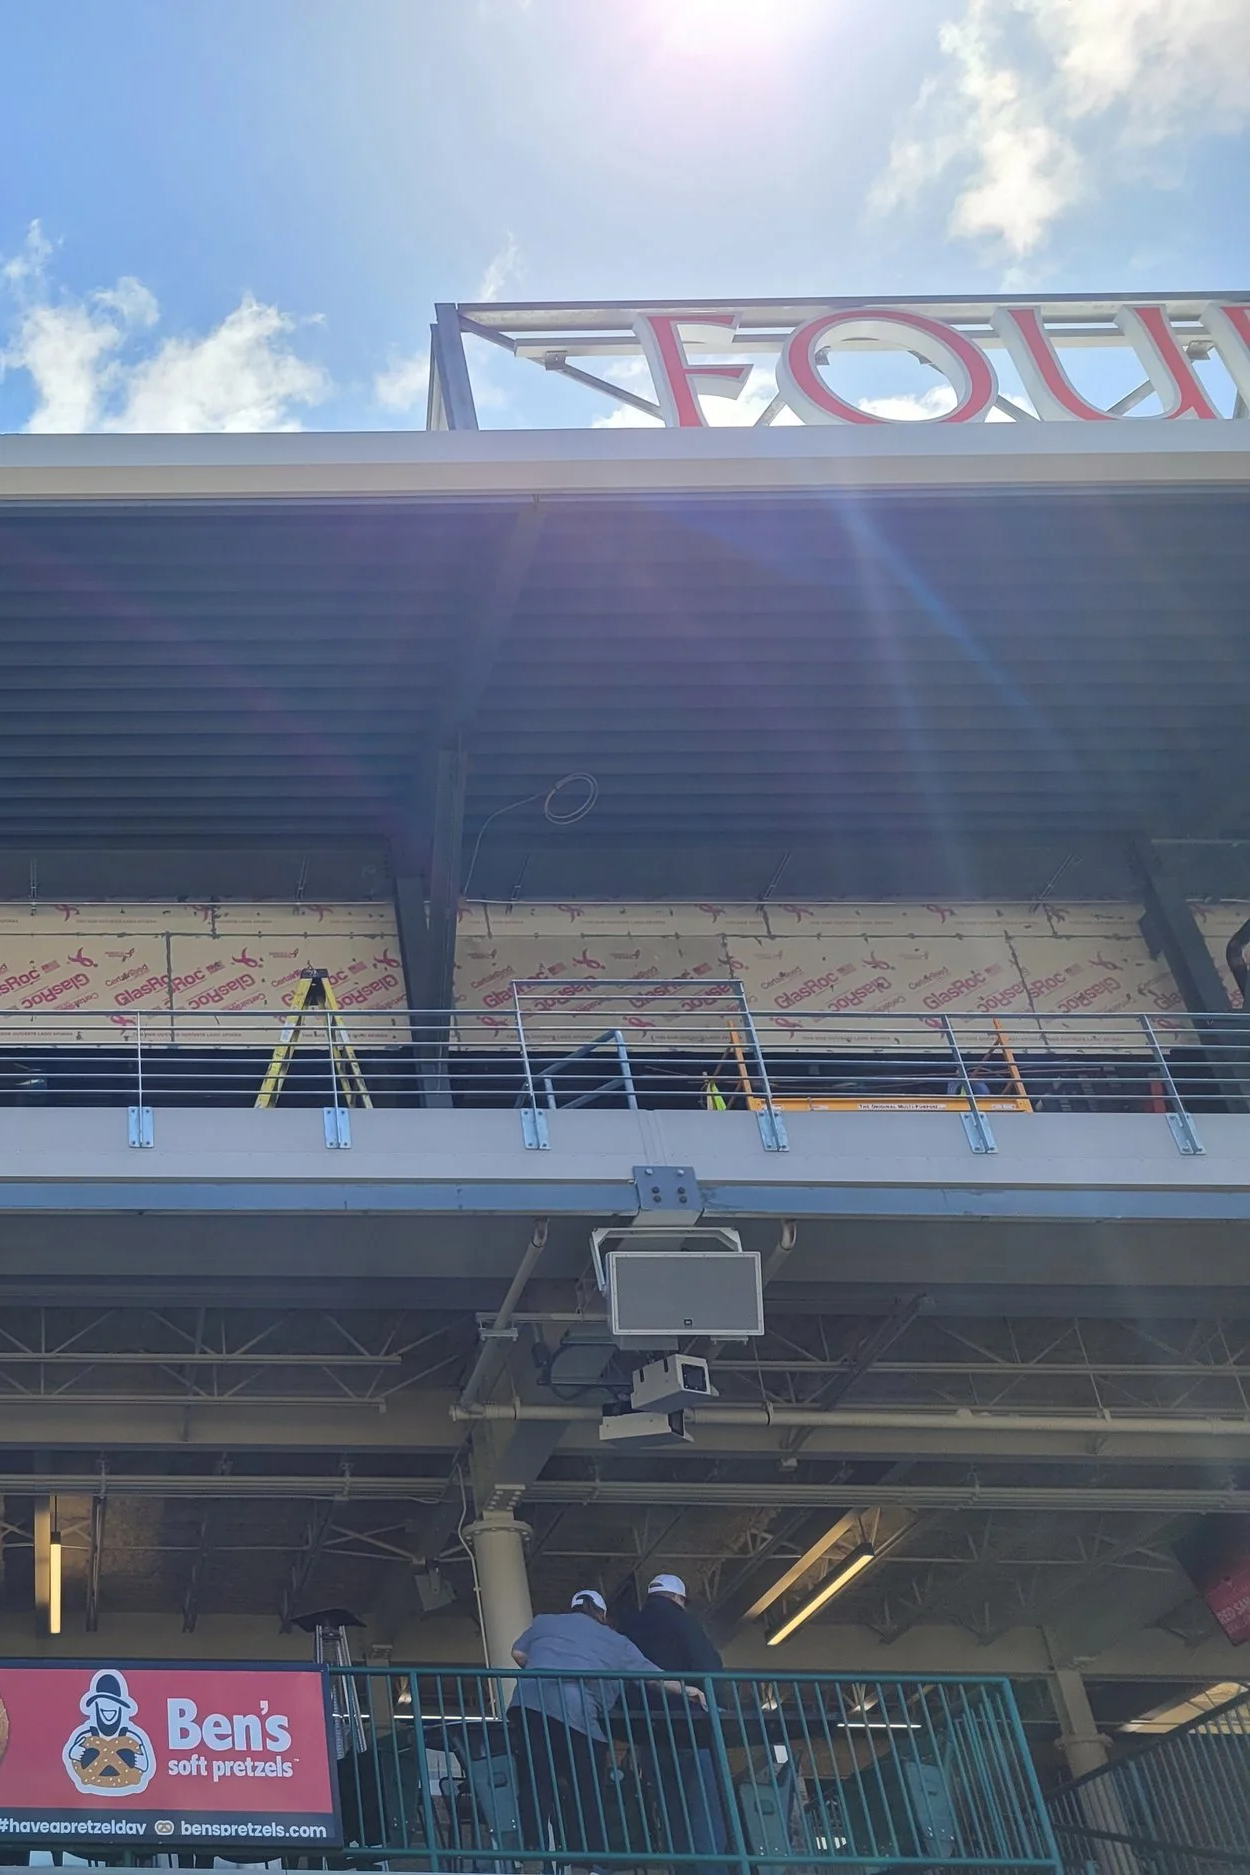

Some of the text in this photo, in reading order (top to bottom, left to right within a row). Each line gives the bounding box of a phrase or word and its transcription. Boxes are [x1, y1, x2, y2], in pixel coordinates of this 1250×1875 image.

[21, 973, 90, 1009] GlasRoc
[188, 973, 256, 1010] GlasRoc
[774, 972, 839, 1009] GlasRoc
[922, 972, 986, 1010] GlasRoc
[1058, 976, 1121, 1013] GlasRoc
[167, 1698, 292, 1752] Ben's
[168, 1754, 208, 1776] soft
[181, 1820, 327, 1838] benspretzels.com
